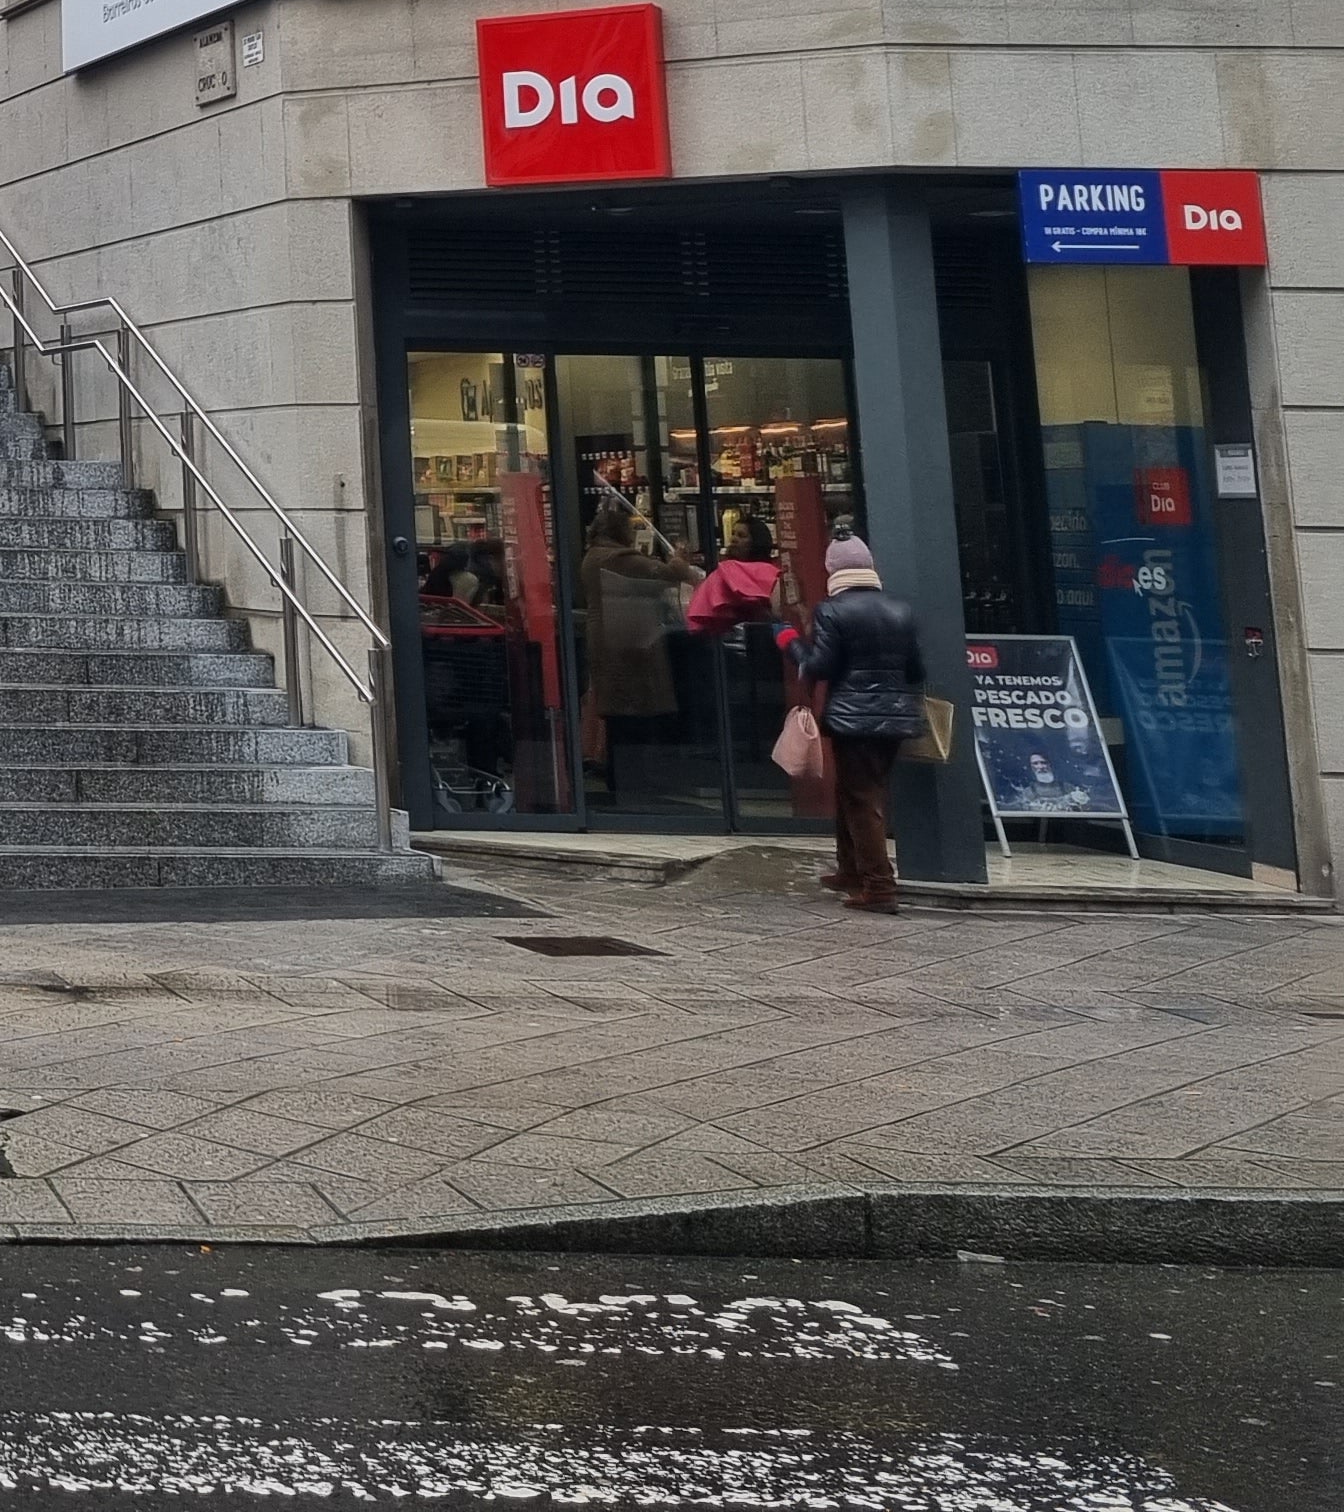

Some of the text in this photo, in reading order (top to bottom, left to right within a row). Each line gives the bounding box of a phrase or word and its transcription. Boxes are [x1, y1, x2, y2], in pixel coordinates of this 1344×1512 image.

[502, 70, 636, 129] Dia
[1038, 183, 1146, 212] PARKING
[1182, 204, 1243, 230] Dia
[1052, 226, 1076, 236] GRATIS
[1081, 227, 1109, 236] COMPRA
[975, 674, 1064, 686] YA TENEMOS
[973, 688, 1073, 706] PESCADO
[971, 705, 1089, 729] FRESCO
